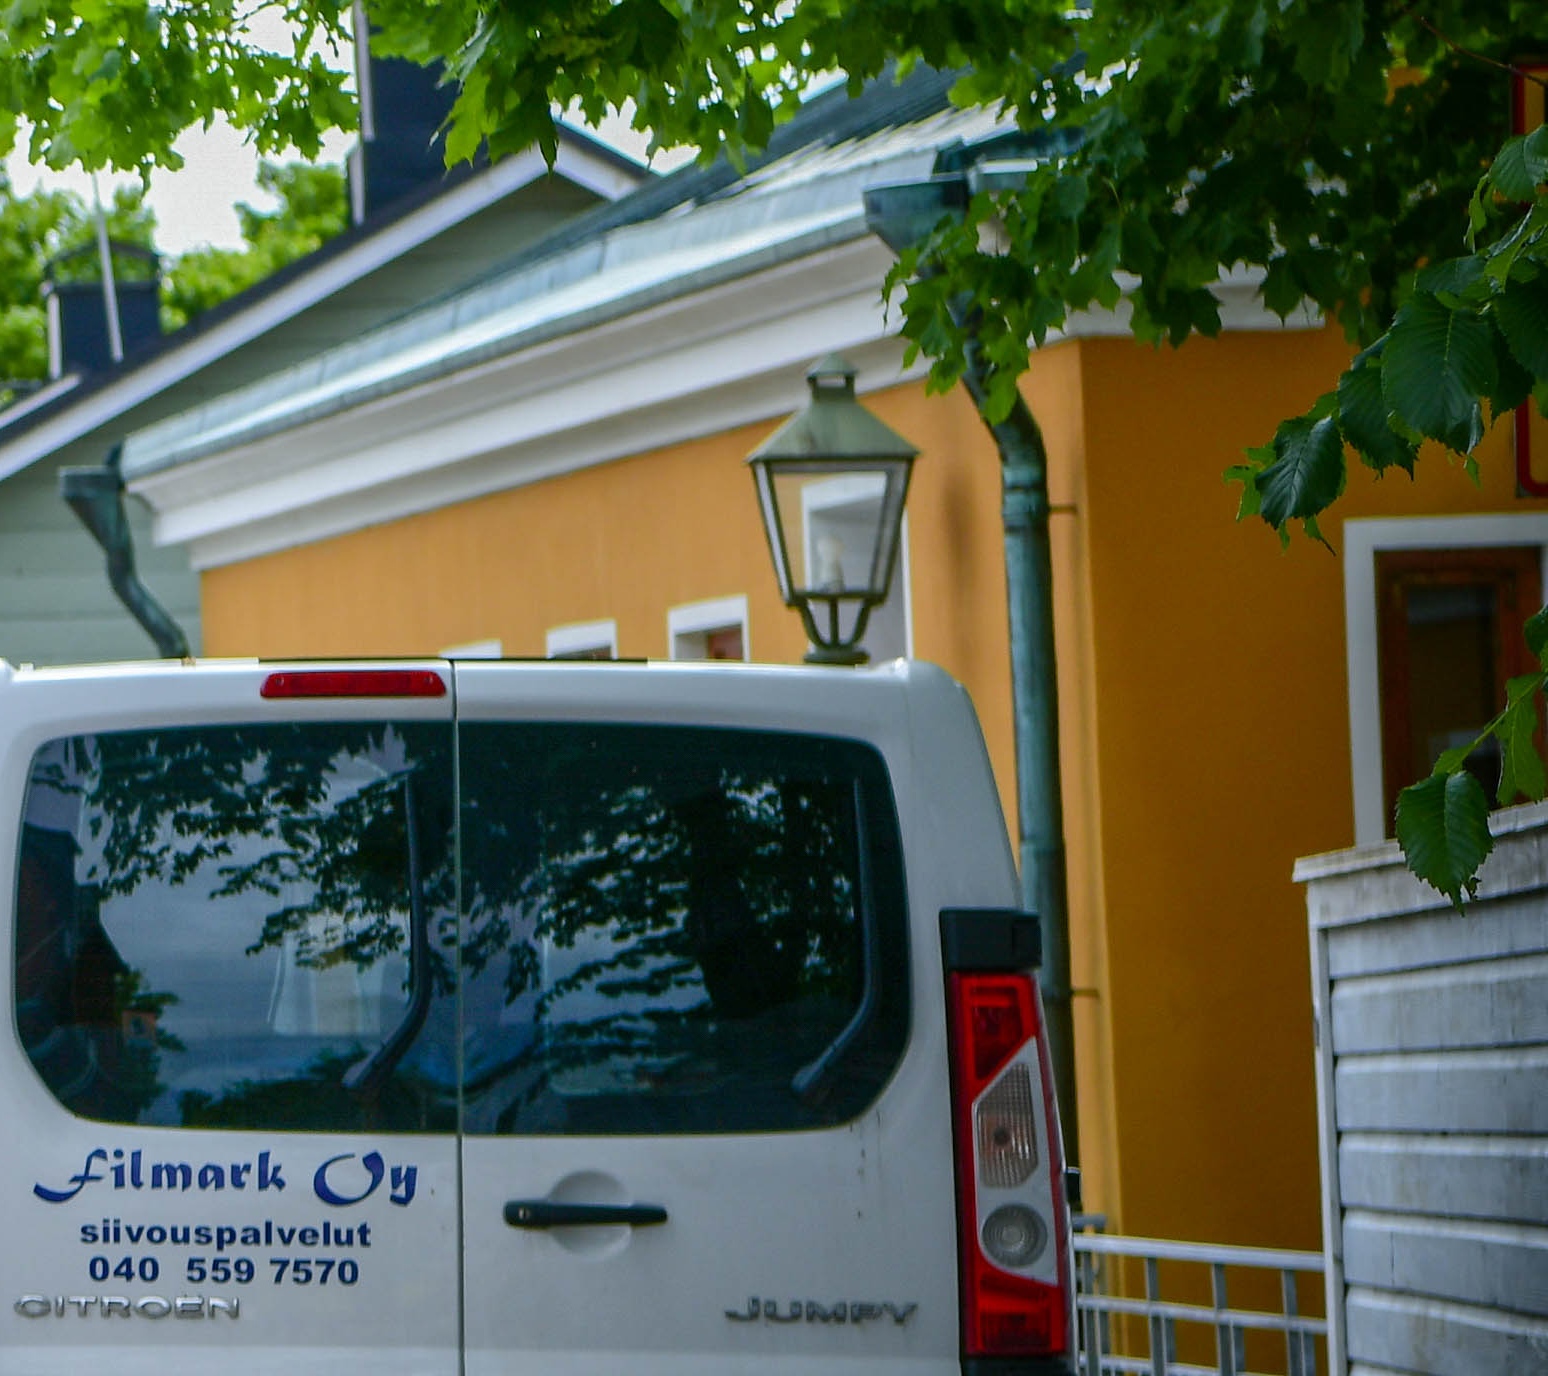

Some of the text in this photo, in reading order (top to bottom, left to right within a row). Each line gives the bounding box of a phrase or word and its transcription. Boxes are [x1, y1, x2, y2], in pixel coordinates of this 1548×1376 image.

[313, 1151, 418, 1206] Oy
[80, 1219, 372, 1251] siivouspalvelut
[88, 1256, 359, 1285] 040 559 7570
[724, 1297, 919, 1323] JUMPY
